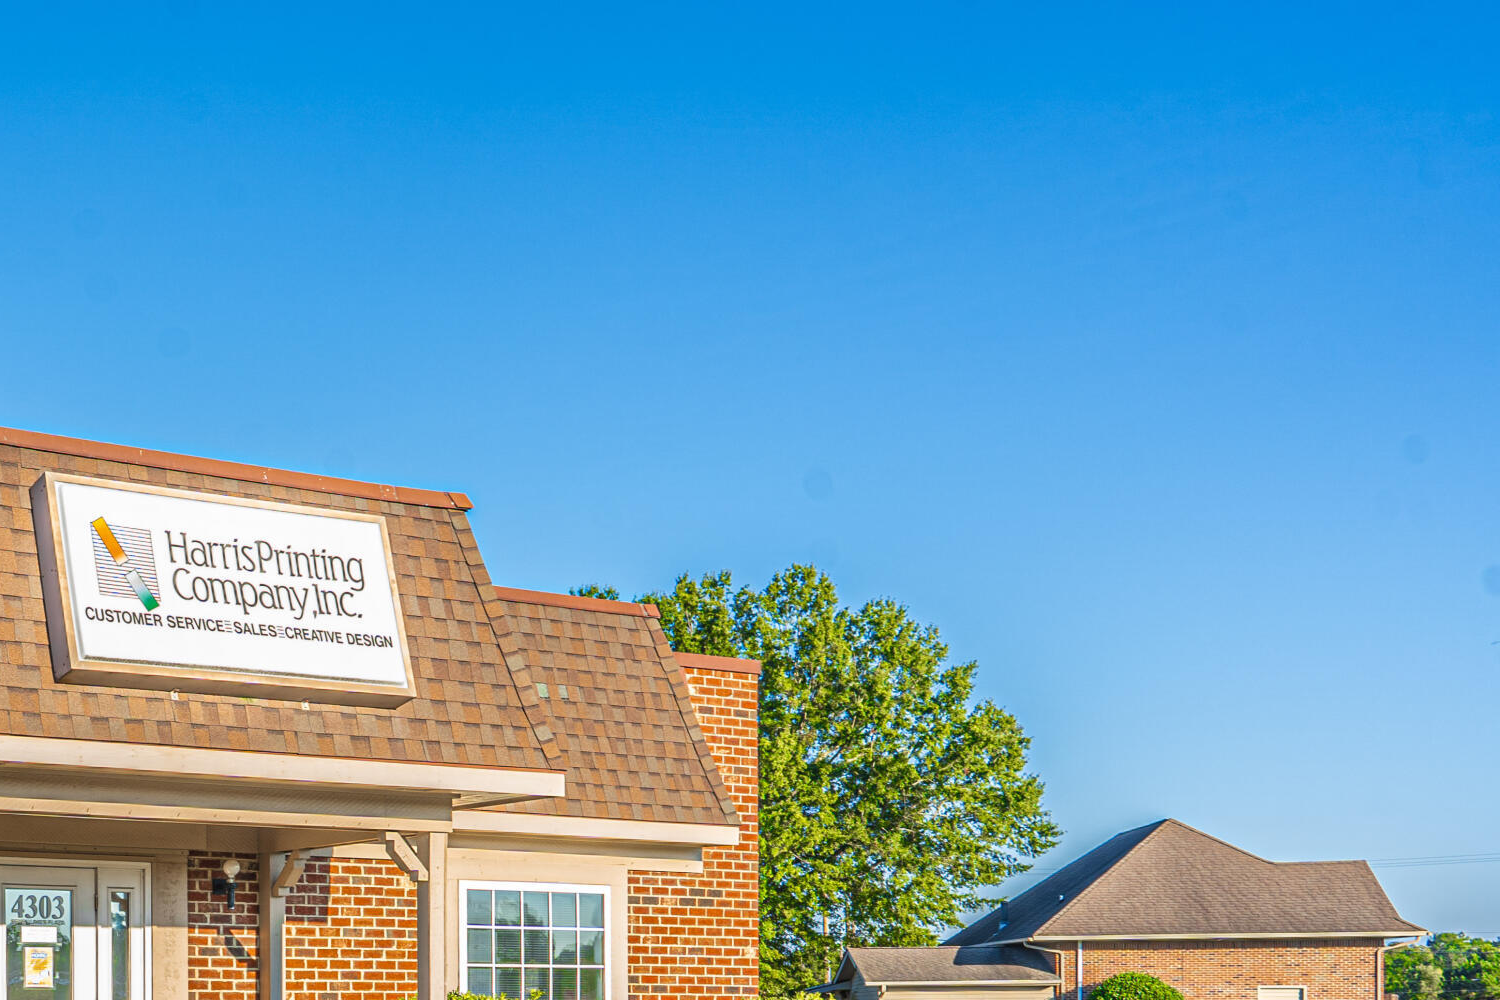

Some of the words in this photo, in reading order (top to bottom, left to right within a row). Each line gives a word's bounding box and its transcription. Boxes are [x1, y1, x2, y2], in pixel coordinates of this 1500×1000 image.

[85, 606, 163, 627] CUSTOMER
[166, 615, 226, 633] SERVICE
[233, 621, 278, 638] SALES
[284, 626, 344, 645] CREATIVE
[346, 633, 394, 649] DESIGN
[11, 894, 65, 920] 4303
